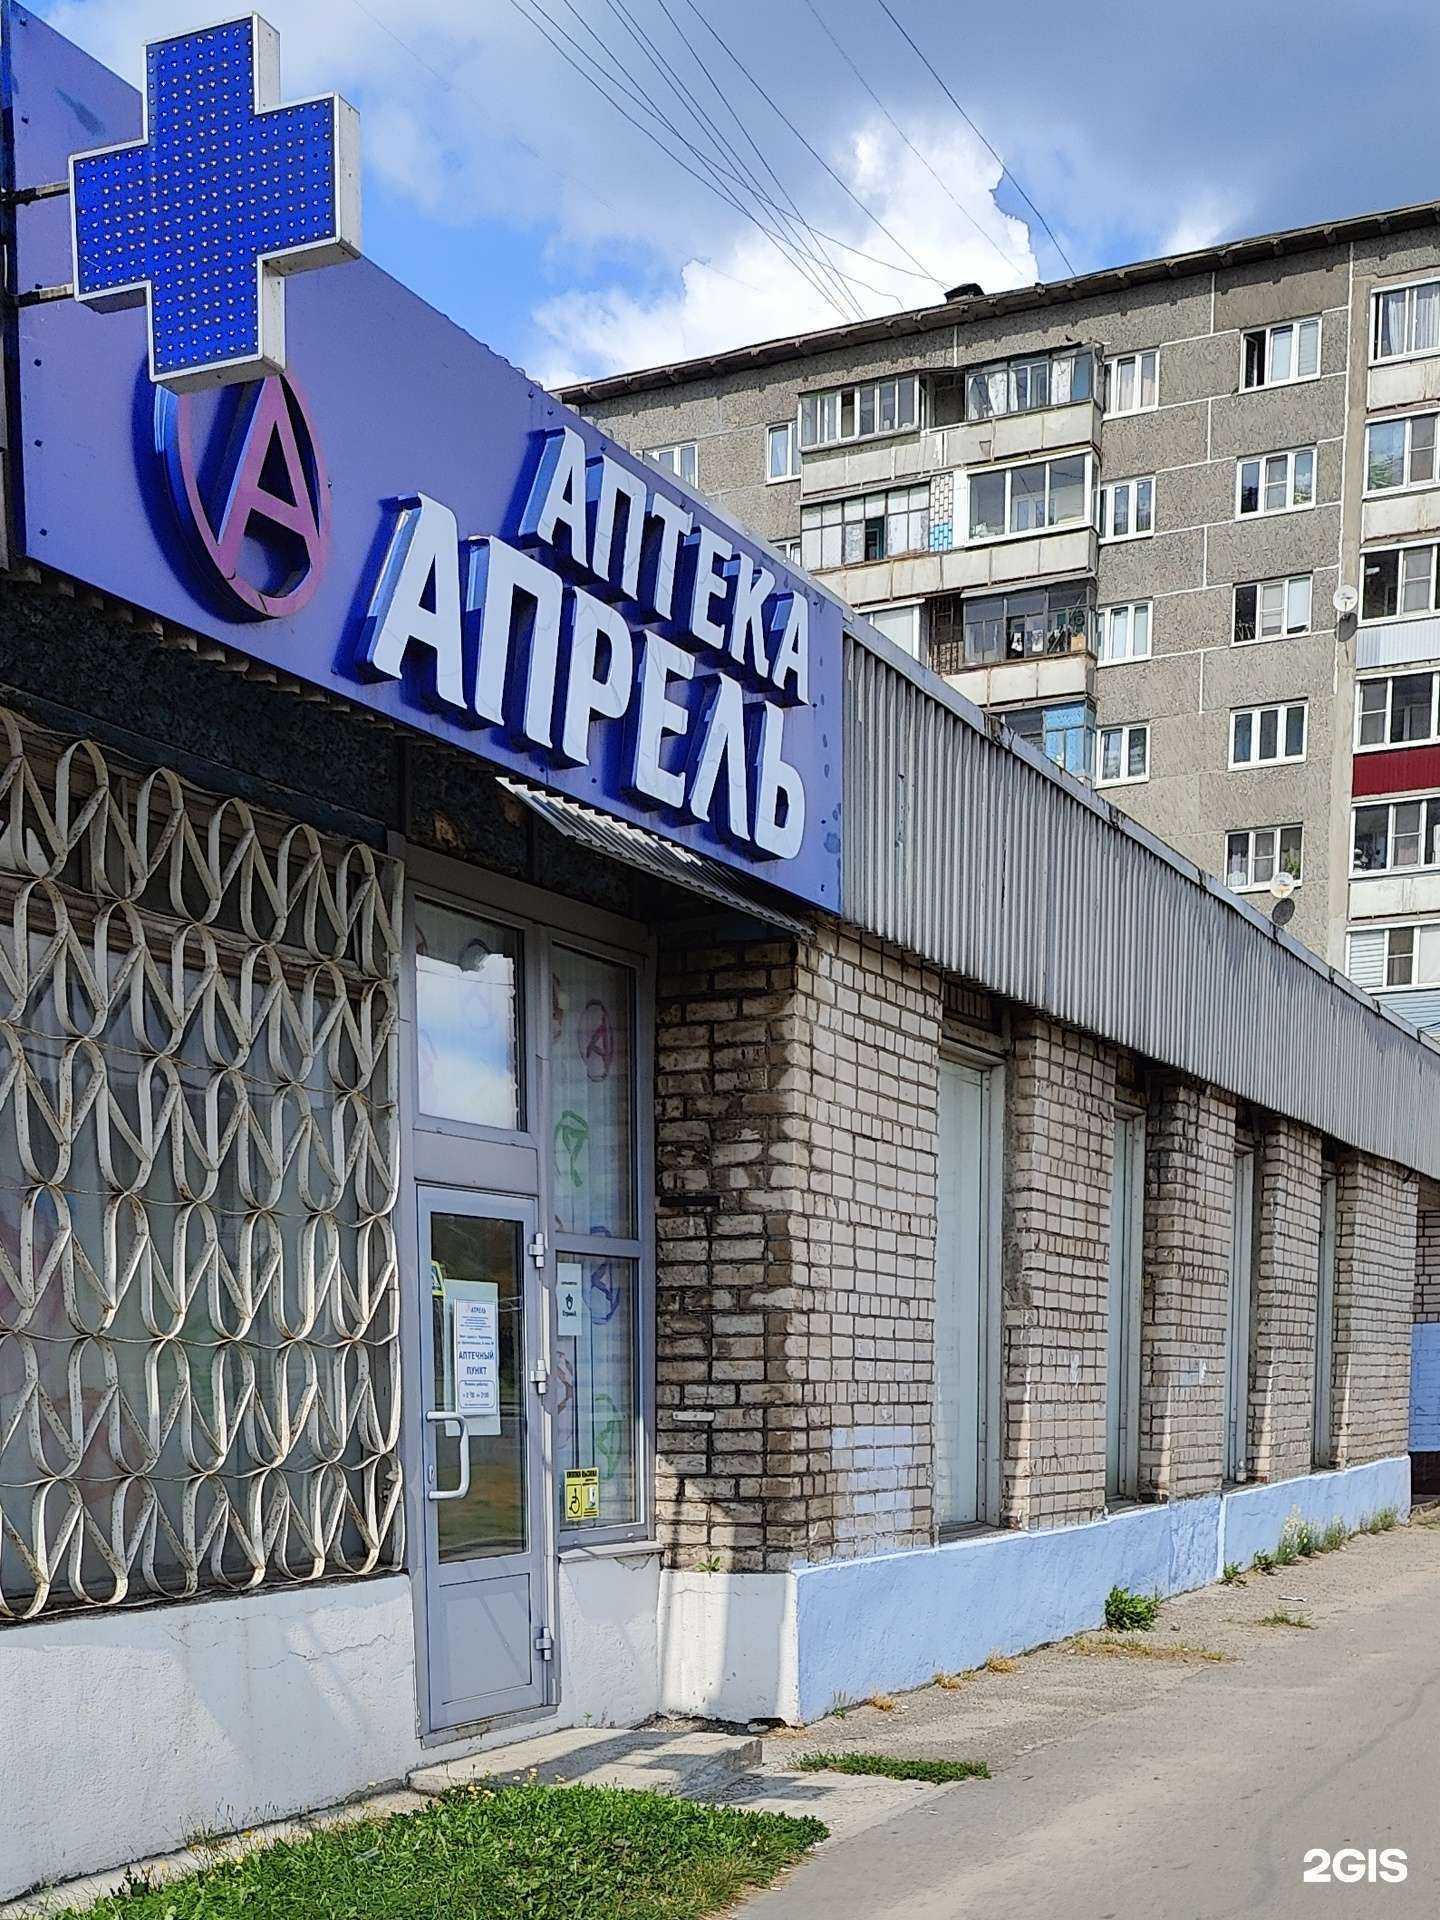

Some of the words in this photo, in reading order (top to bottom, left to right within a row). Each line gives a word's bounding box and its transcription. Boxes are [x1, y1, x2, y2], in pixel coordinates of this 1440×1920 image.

[534, 426, 809, 704] АПТЕКА
[371, 492, 807, 860] АПРЕЛЬ
[458, 1350, 494, 1361] АПТЕЧНЫЙ
[466, 1366, 488, 1375] ПУНКТ
